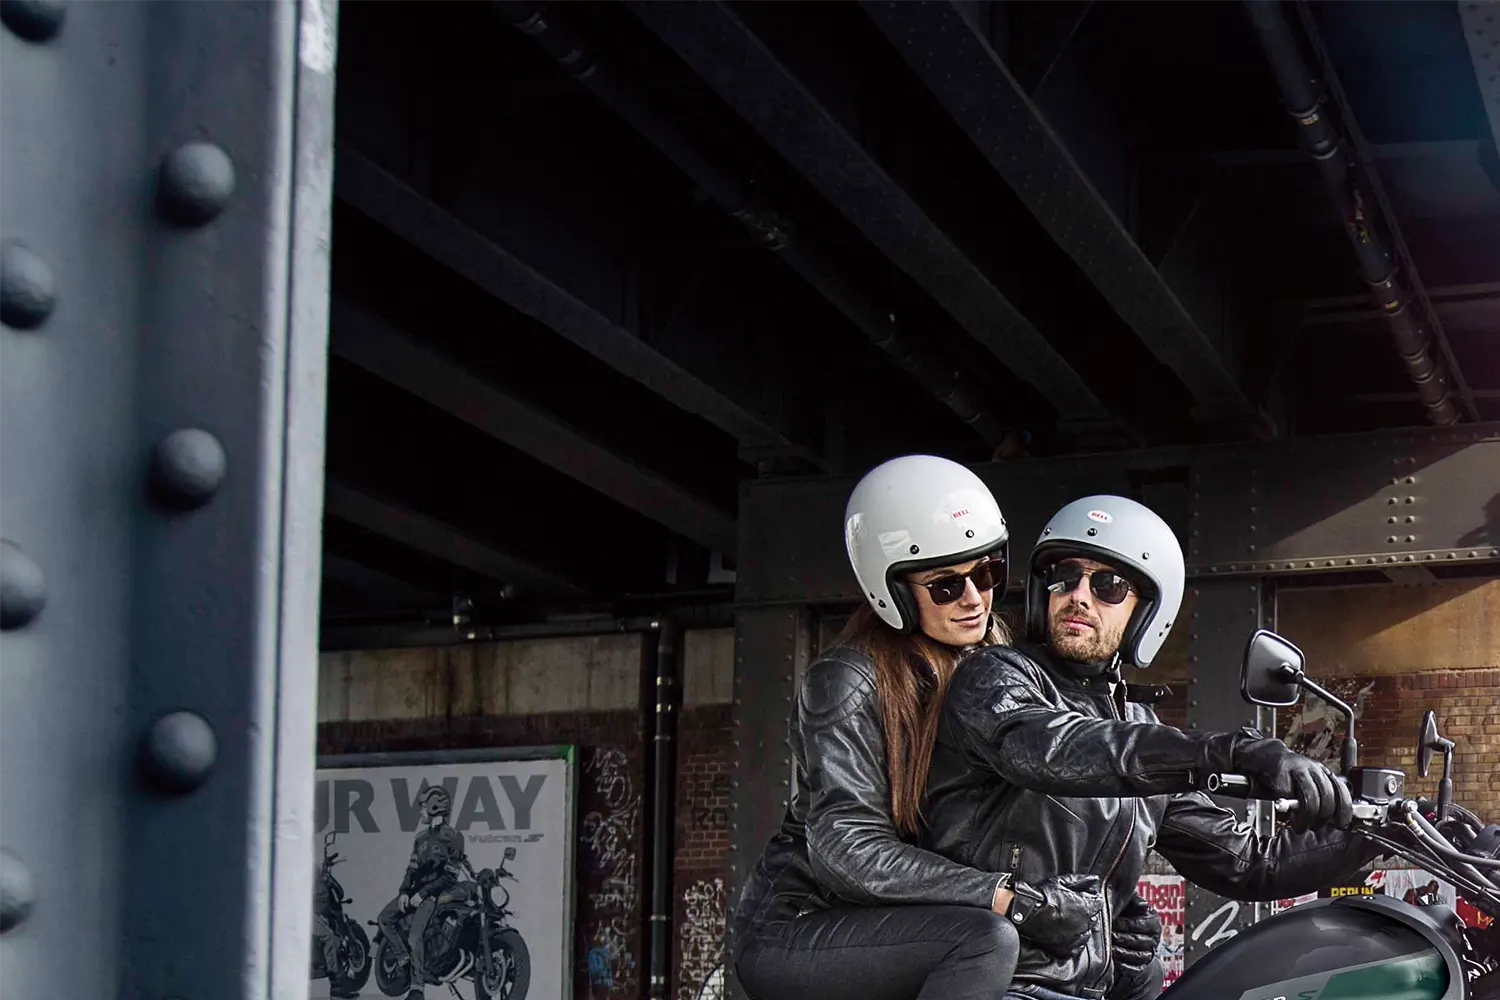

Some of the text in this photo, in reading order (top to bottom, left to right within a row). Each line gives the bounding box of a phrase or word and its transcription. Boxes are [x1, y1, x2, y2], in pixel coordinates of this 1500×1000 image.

[952, 508, 969, 519] BELL
[1091, 512, 1108, 521] BELL
[390, 775, 548, 832] WAY
